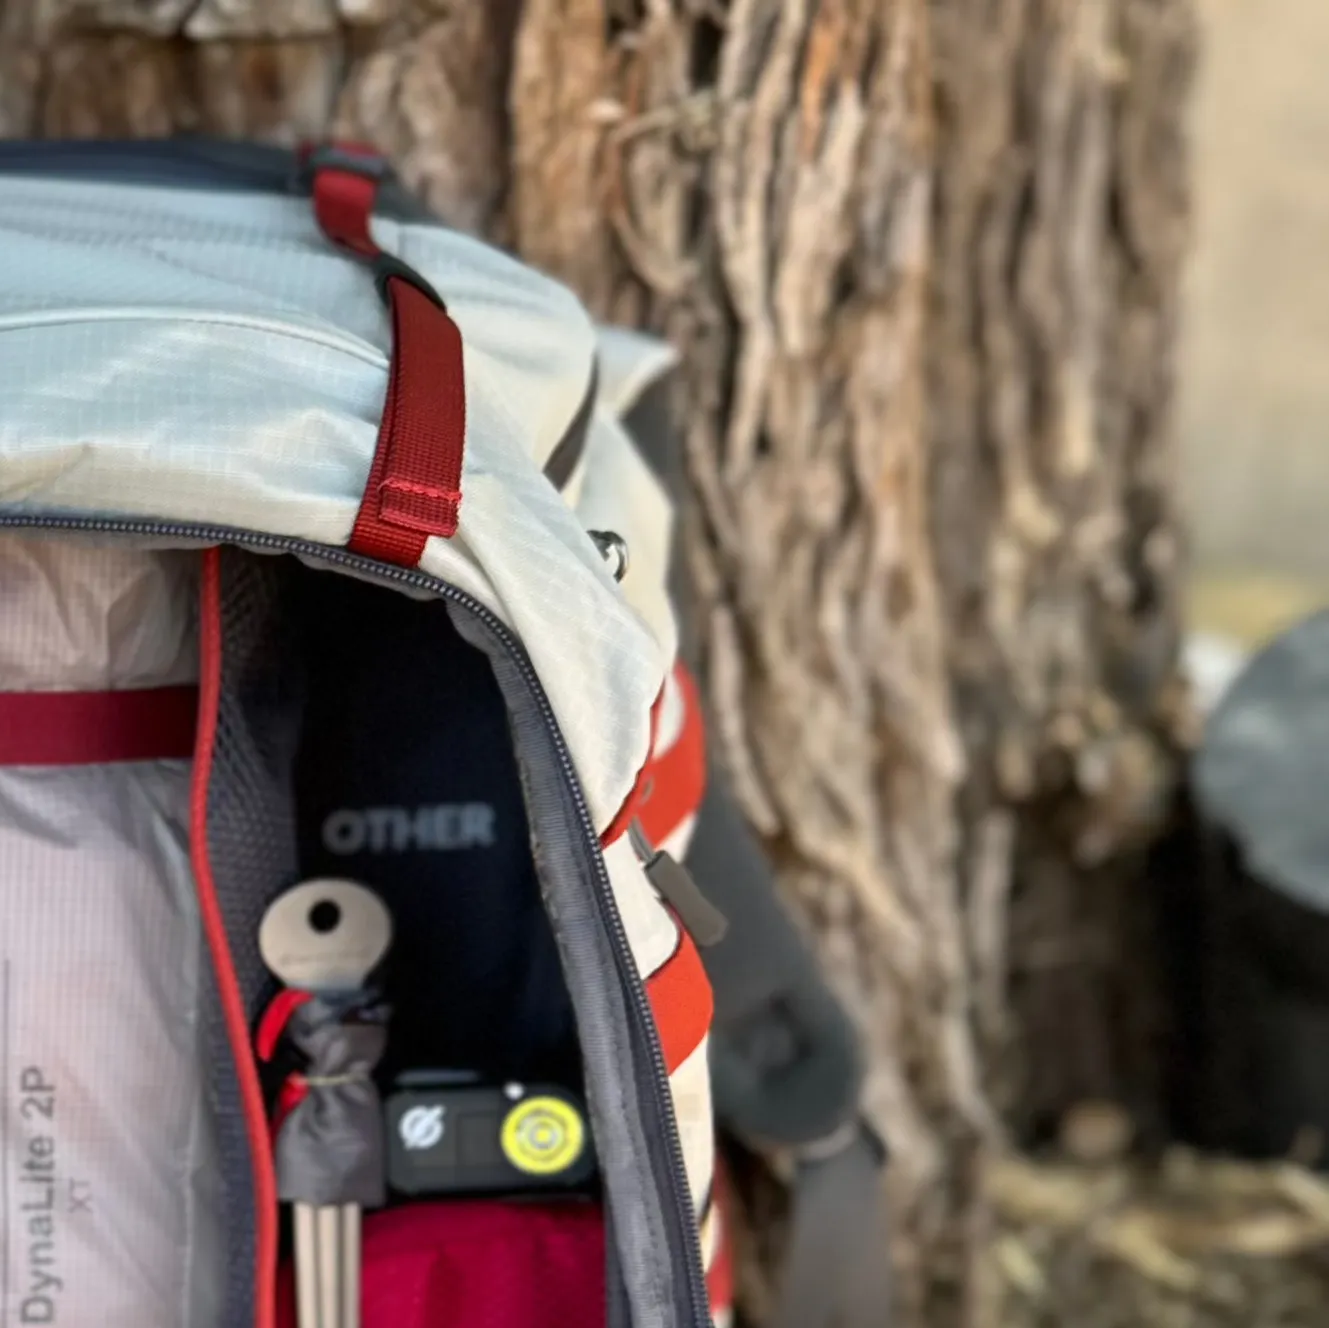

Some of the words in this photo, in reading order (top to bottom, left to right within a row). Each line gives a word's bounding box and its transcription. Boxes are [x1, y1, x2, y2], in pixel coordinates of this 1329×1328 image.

[321, 802, 497, 856] OTHER
[20, 1065, 56, 1121] 2P
[67, 1178, 93, 1216] XT
[20, 1131, 63, 1326] DynaLite
